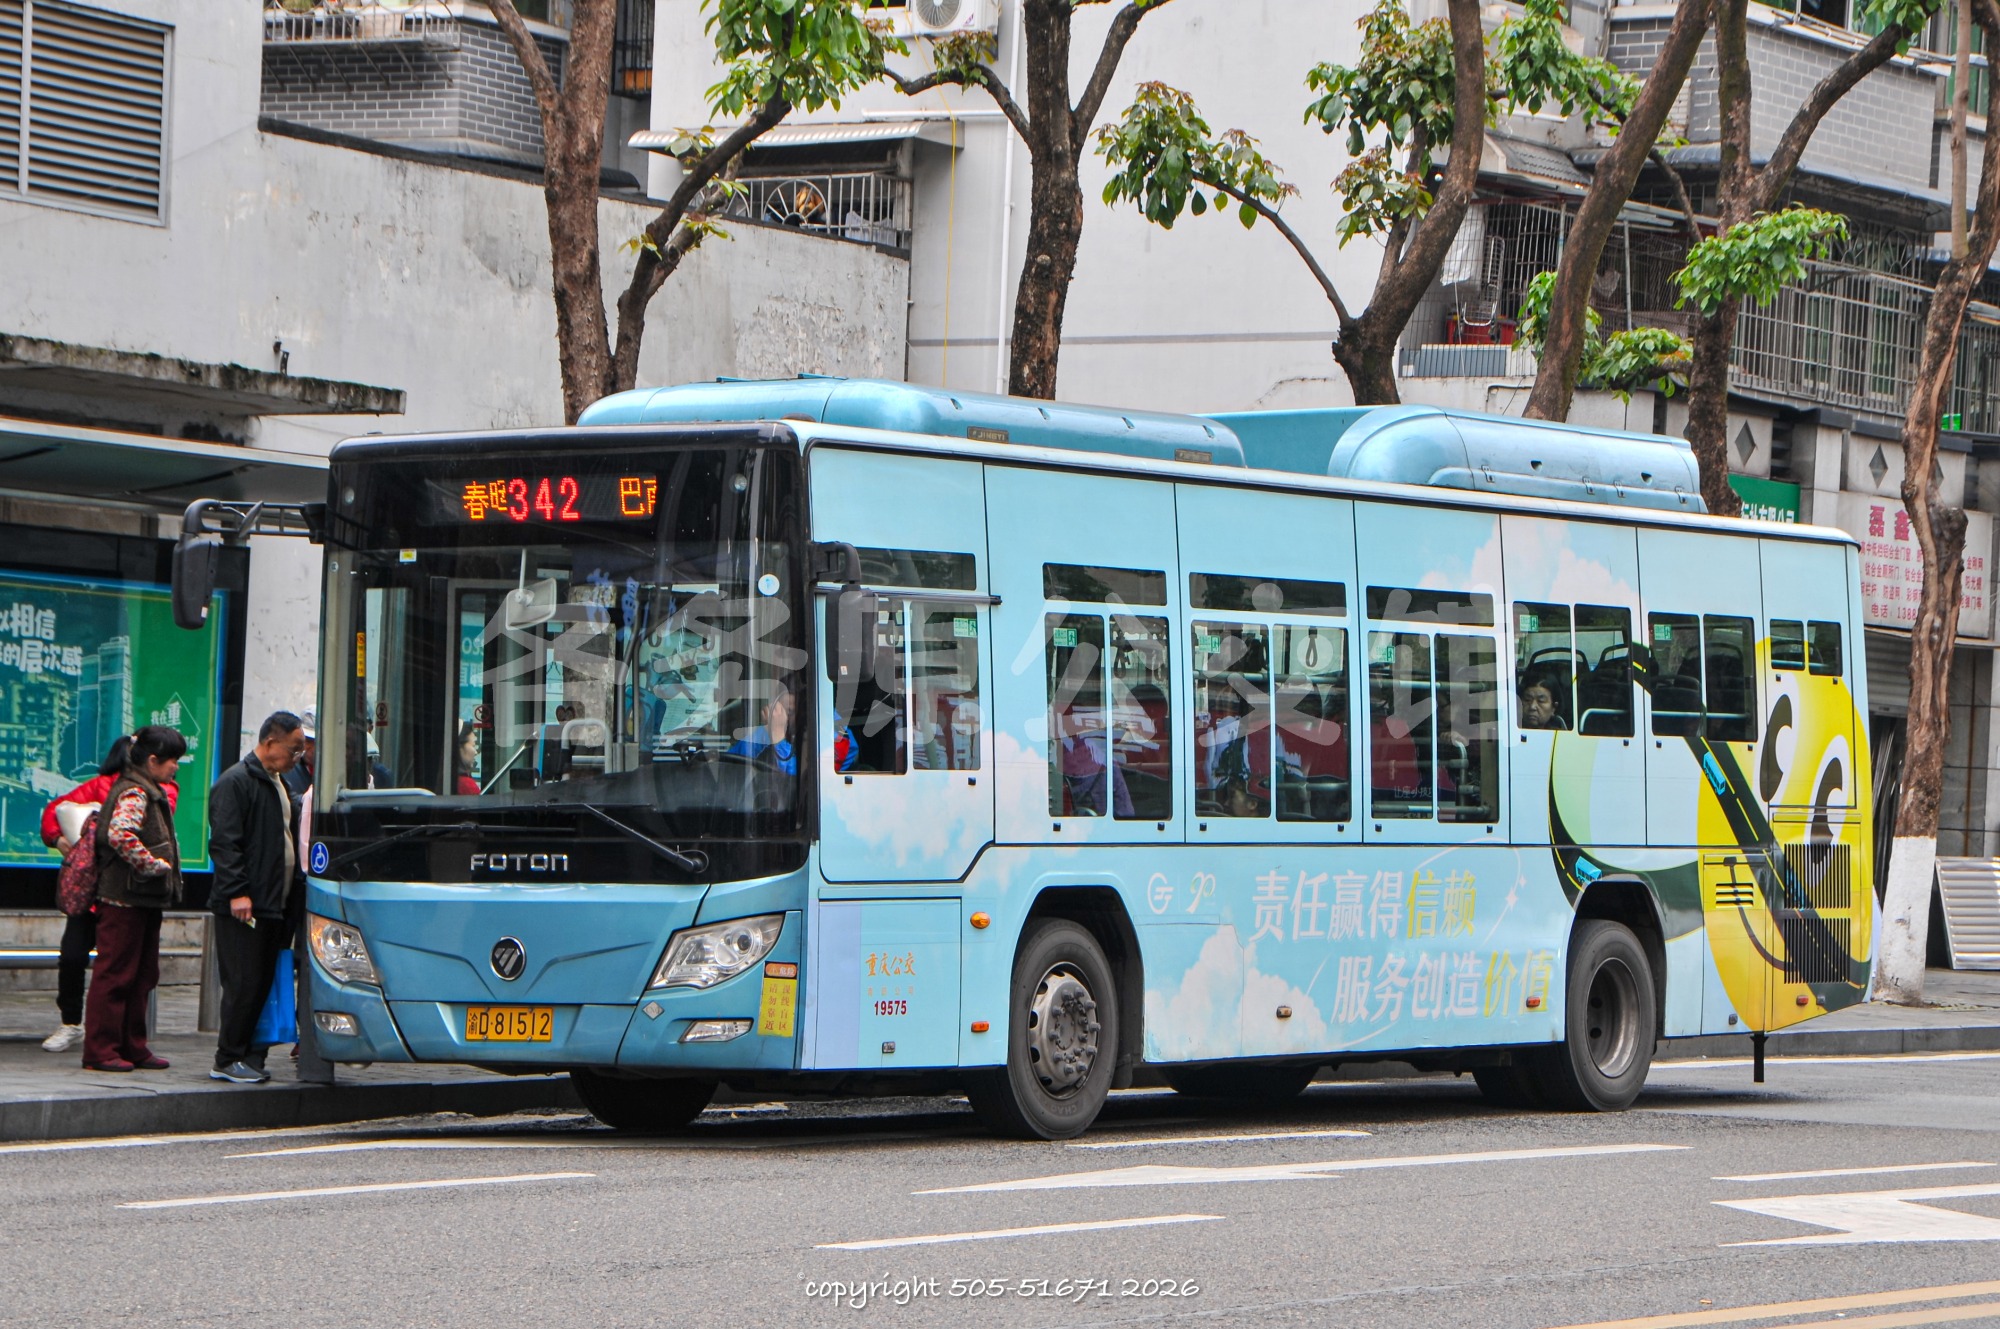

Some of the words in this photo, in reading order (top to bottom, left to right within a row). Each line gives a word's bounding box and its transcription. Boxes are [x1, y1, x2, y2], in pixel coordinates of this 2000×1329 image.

[508, 477, 580, 521] 342
[470, 853, 568, 871] FOTON
[1248, 869, 1478, 942] 责任赢得信赖
[874, 1000, 907, 1016] 19575
[1331, 948, 1554, 1025] 服务创造价值
